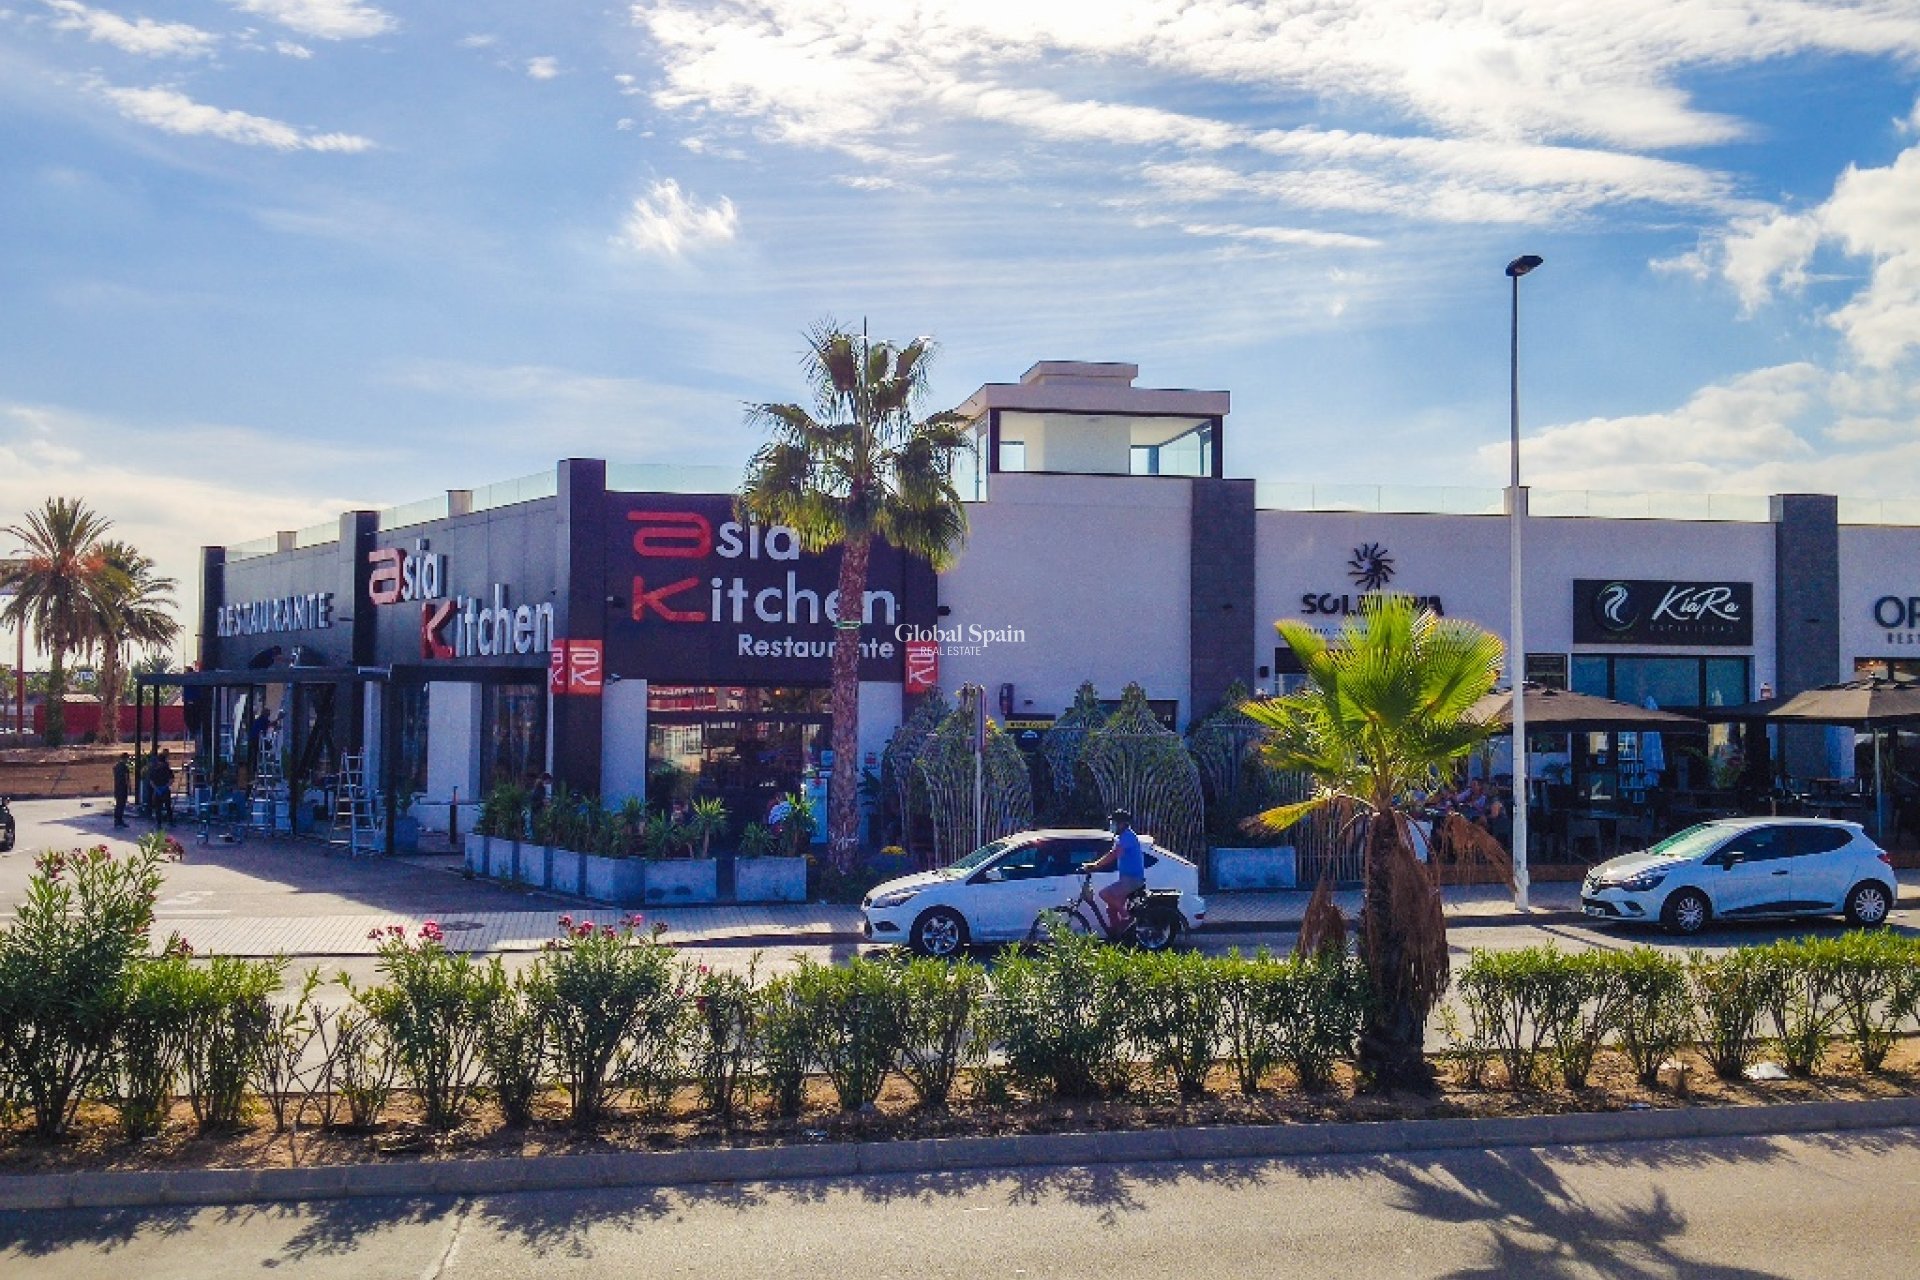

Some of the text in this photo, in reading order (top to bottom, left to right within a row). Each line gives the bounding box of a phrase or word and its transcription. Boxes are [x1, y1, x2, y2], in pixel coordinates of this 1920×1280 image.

[217, 592, 334, 637] RESTAURANTE
[421, 583, 553, 659] Kitchen
[738, 633, 895, 658] Restaurnte
